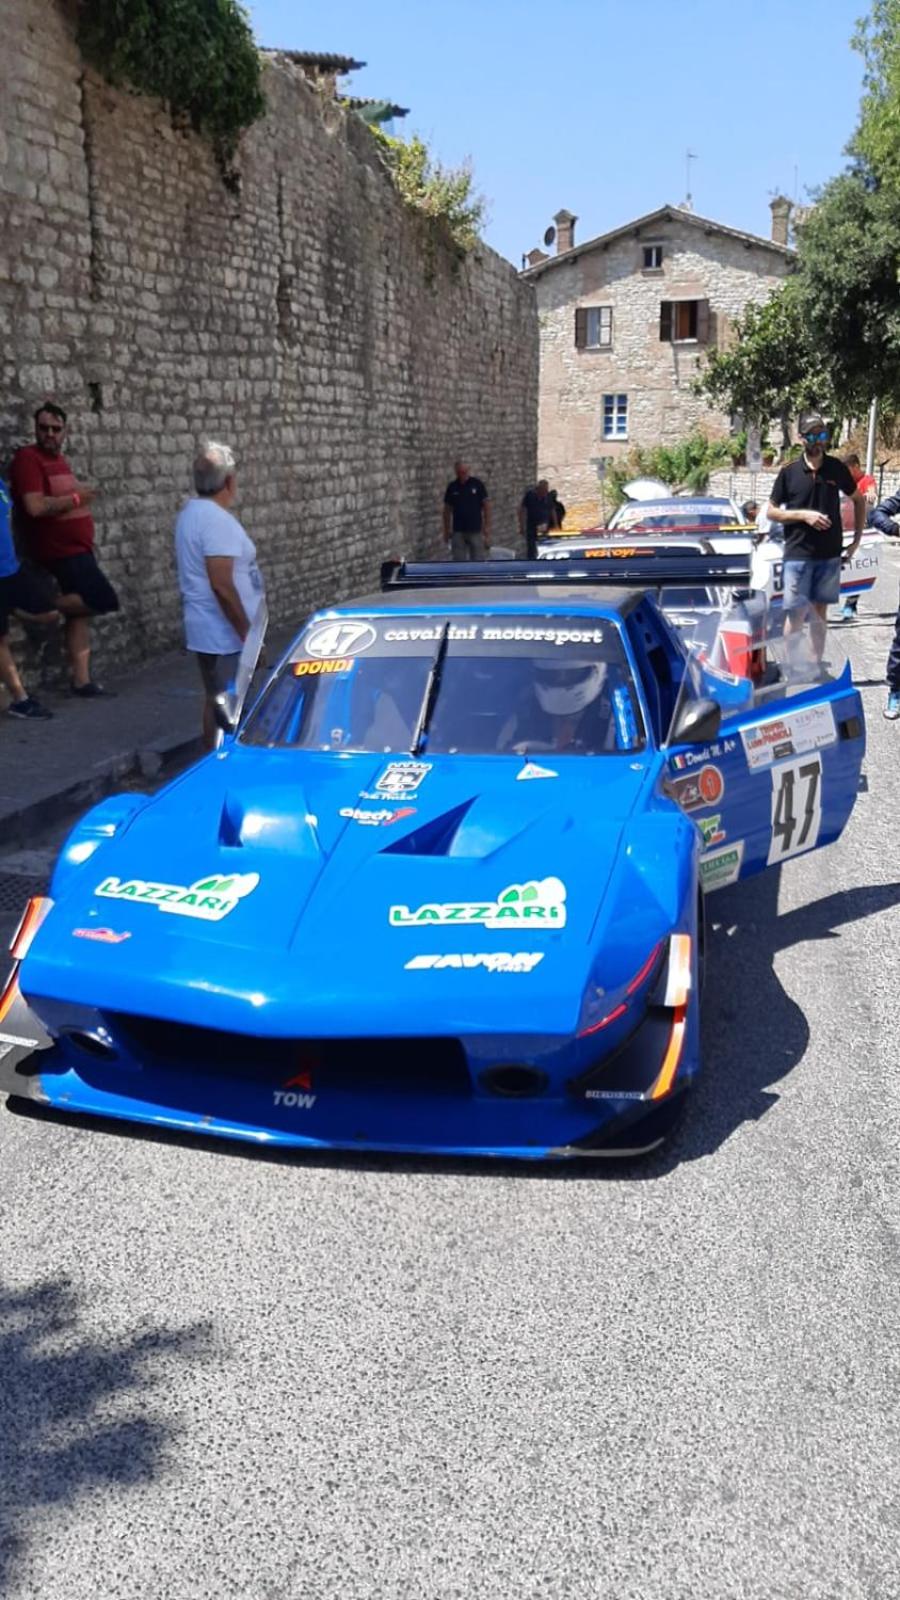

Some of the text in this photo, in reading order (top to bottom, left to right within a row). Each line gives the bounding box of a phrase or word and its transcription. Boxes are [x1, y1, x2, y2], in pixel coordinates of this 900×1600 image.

[311, 624, 361, 655] 47
[384, 626, 603, 645] cavalini motorsport
[295, 660, 354, 676] DONDI
[774, 761, 821, 853] 47
[101, 880, 230, 912] LAZZARI
[393, 905, 559, 922] LAZZARI
[273, 1091, 315, 1109] TOW
